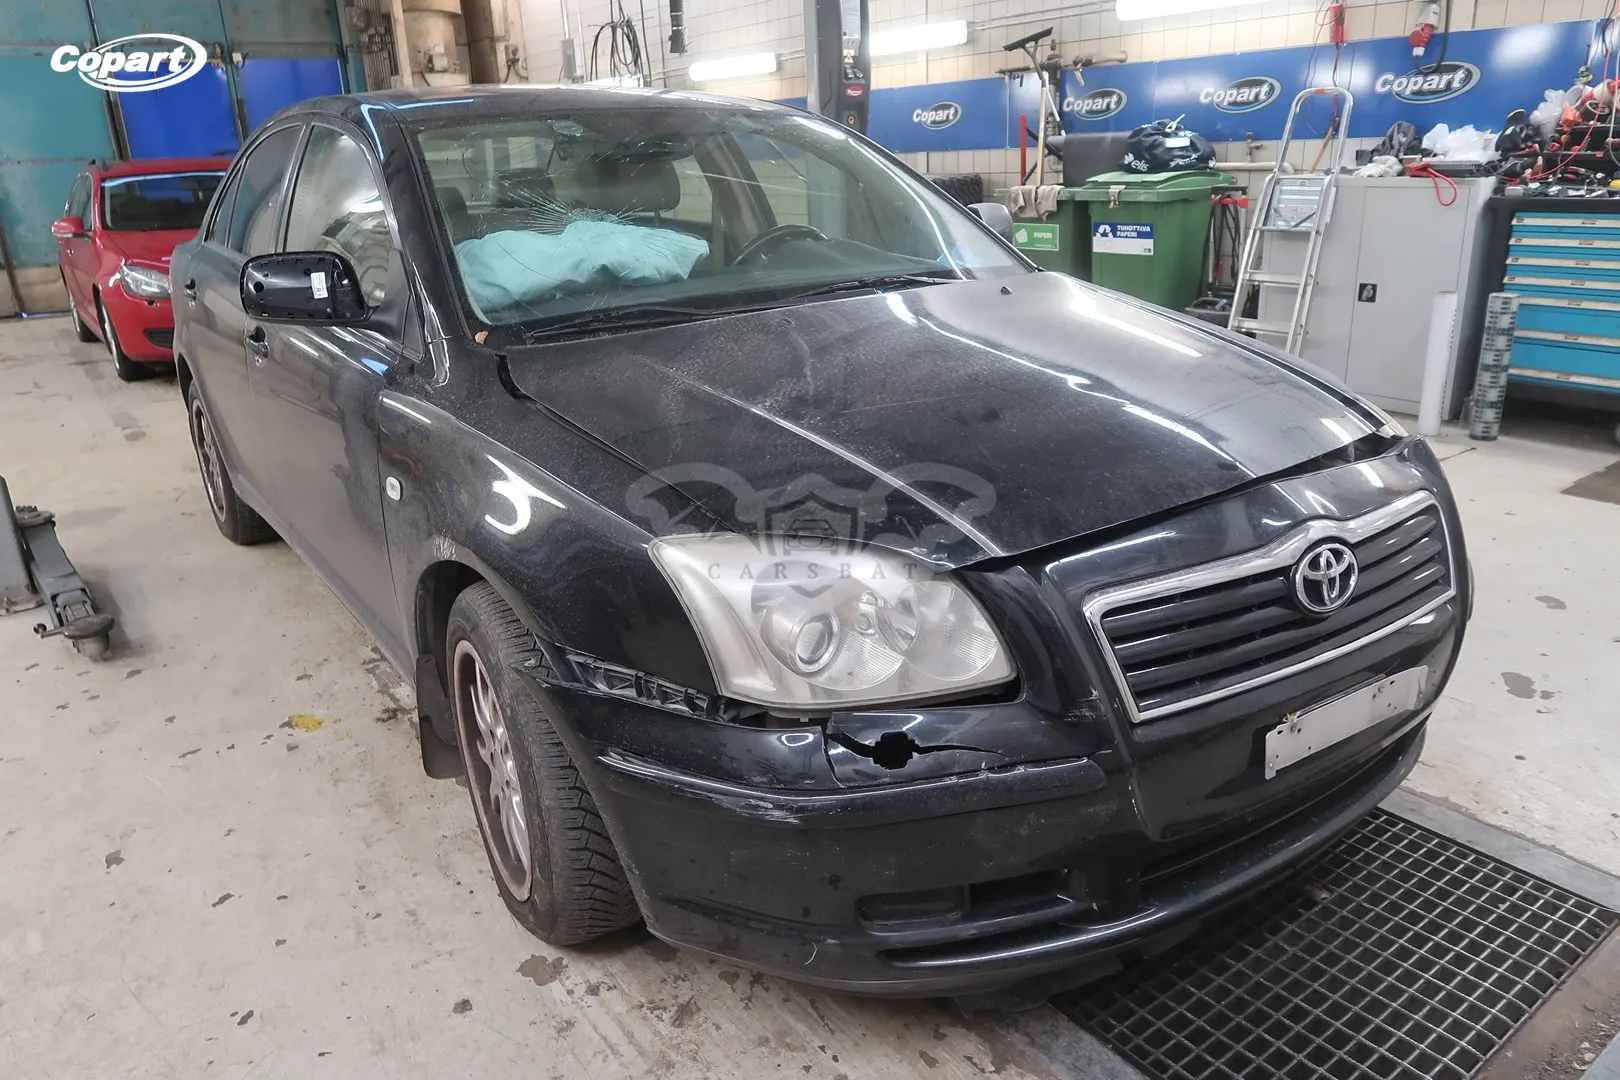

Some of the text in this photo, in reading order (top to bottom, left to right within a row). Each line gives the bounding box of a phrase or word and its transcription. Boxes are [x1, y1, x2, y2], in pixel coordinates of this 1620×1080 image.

[1375, 68, 1467, 96] Copart
[1062, 94, 1119, 114] Copart
[1199, 82, 1271, 106] Copart
[912, 106, 956, 124] Copart
